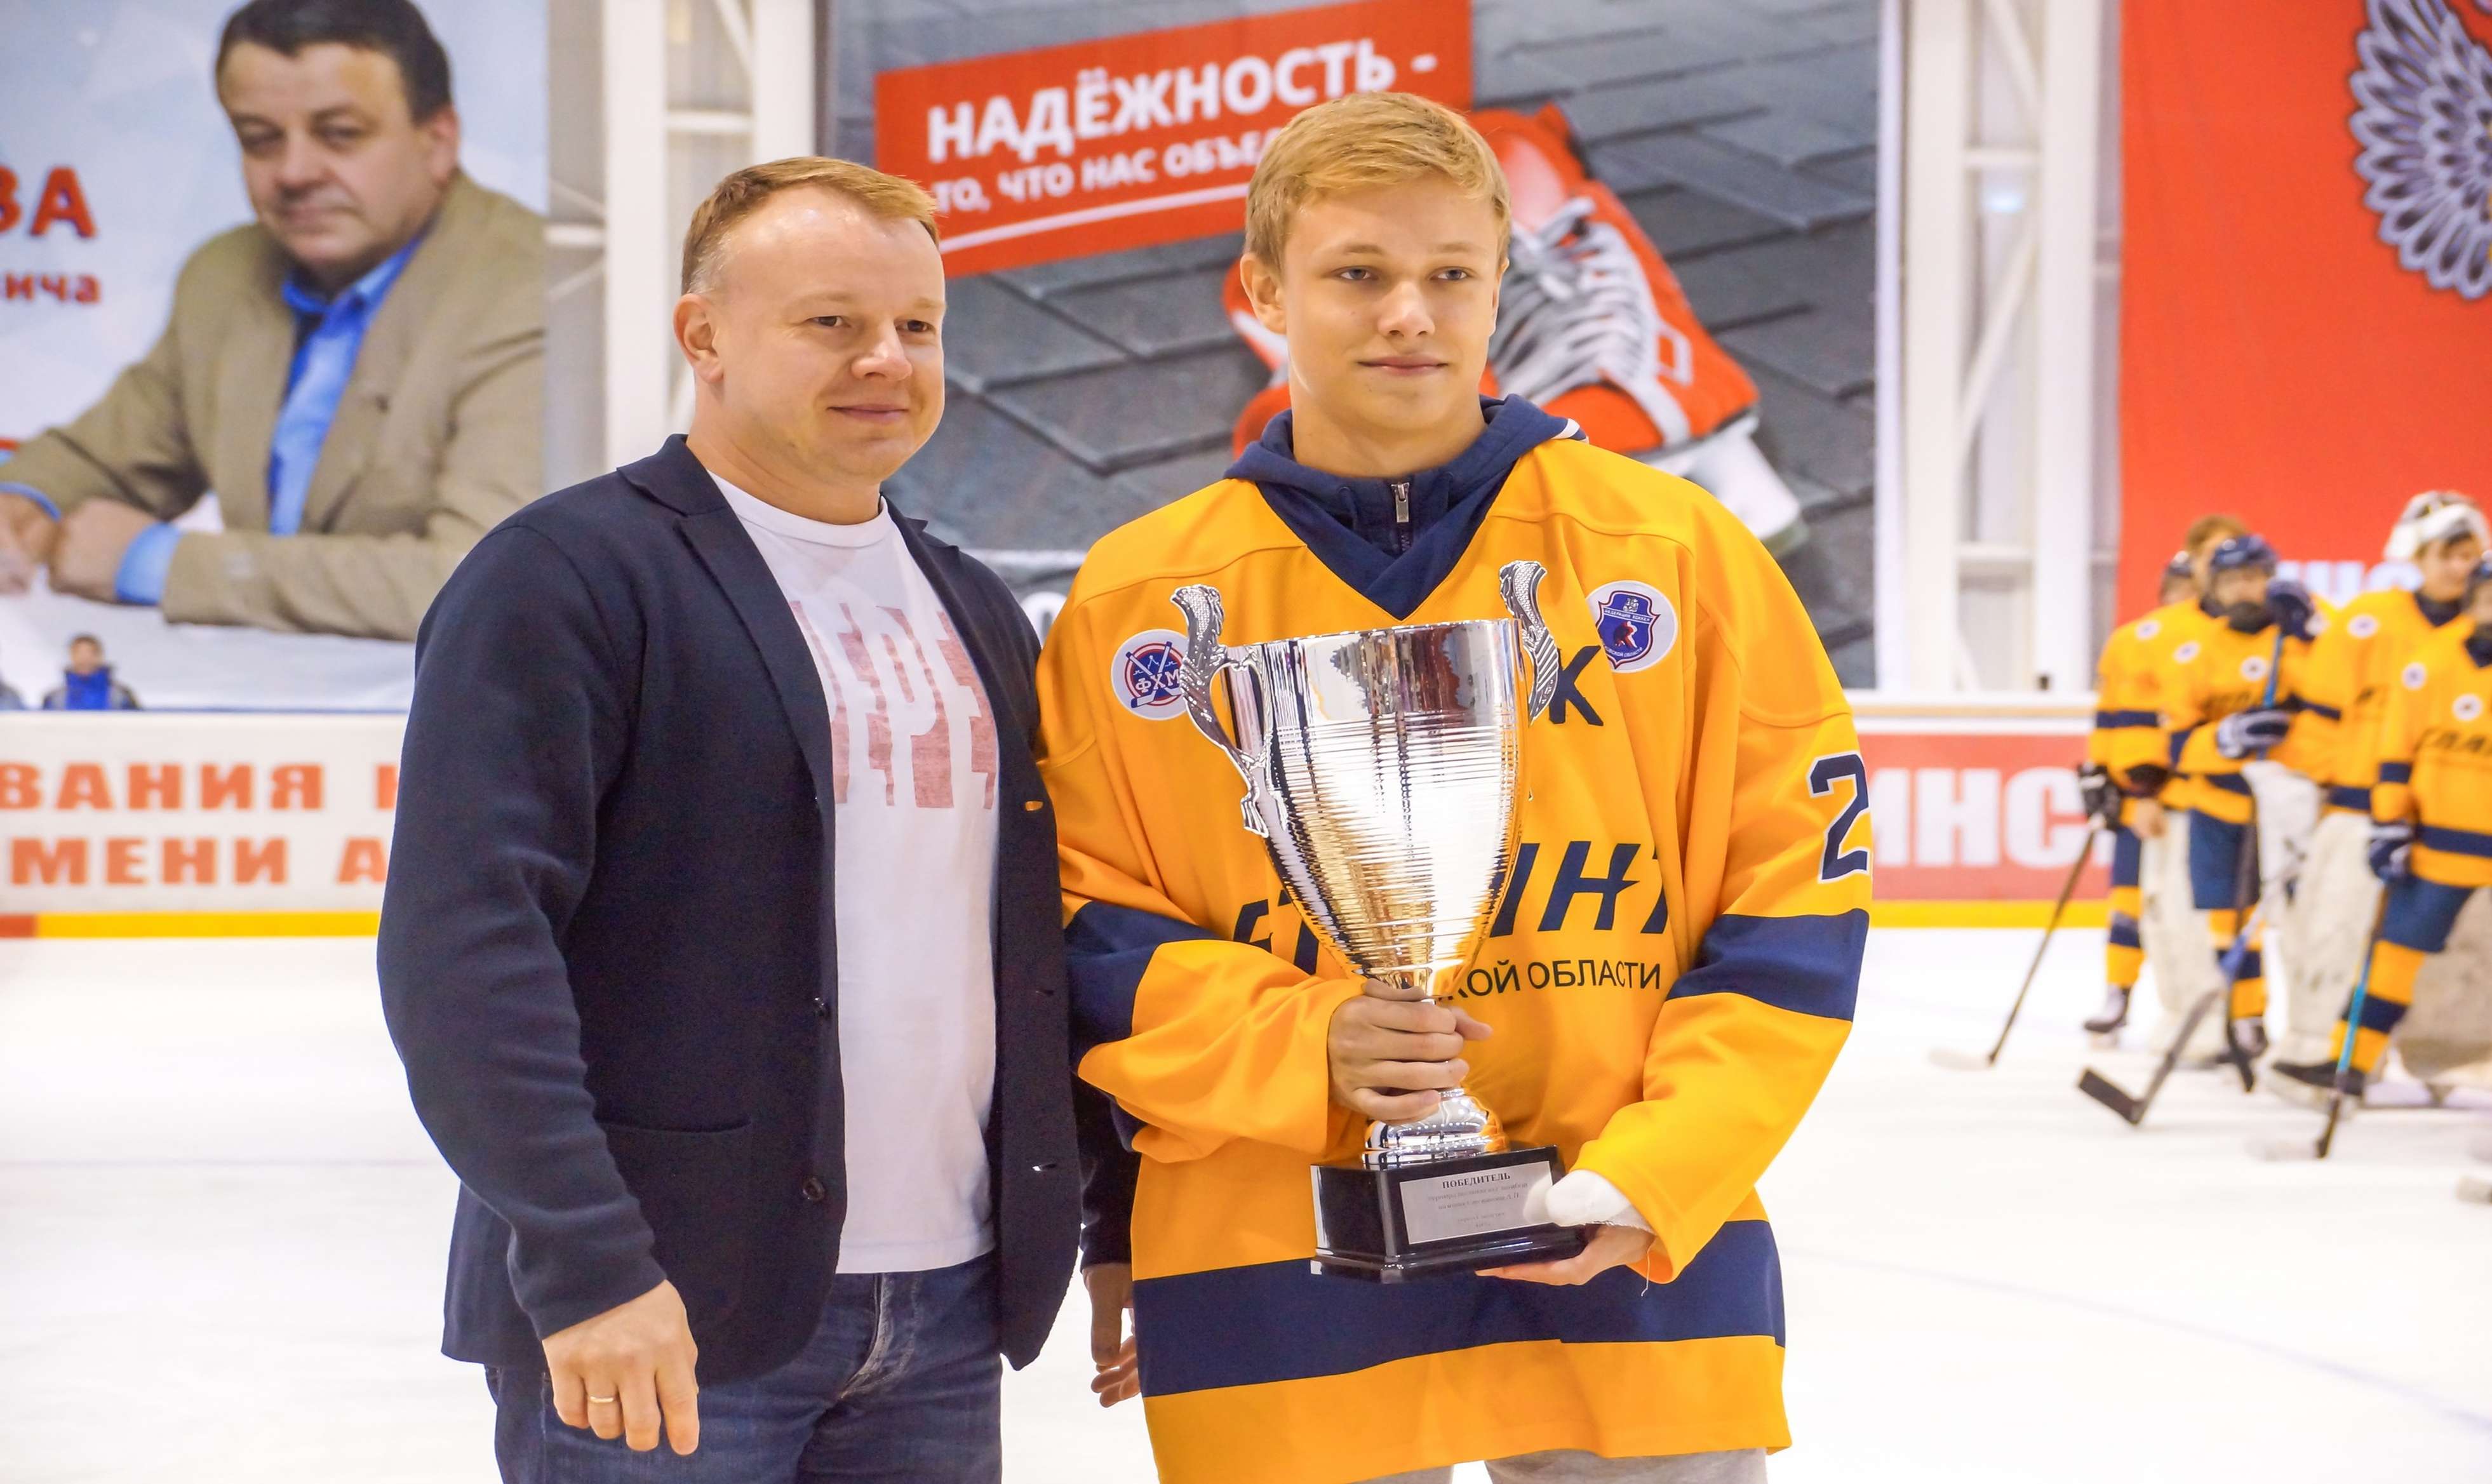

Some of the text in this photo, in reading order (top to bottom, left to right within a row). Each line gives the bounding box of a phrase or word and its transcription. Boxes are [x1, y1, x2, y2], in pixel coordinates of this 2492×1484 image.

[927, 38, 1396, 164] НАДЁЖНОСТЬ
[997, 161, 1075, 203] ЧТО
[1080, 149, 1157, 192] НАС
[1527, 959, 1661, 989] ОБЛАСТИ
[1442, 1172, 1511, 1189] ПОБЕДИТЕЛЬ
